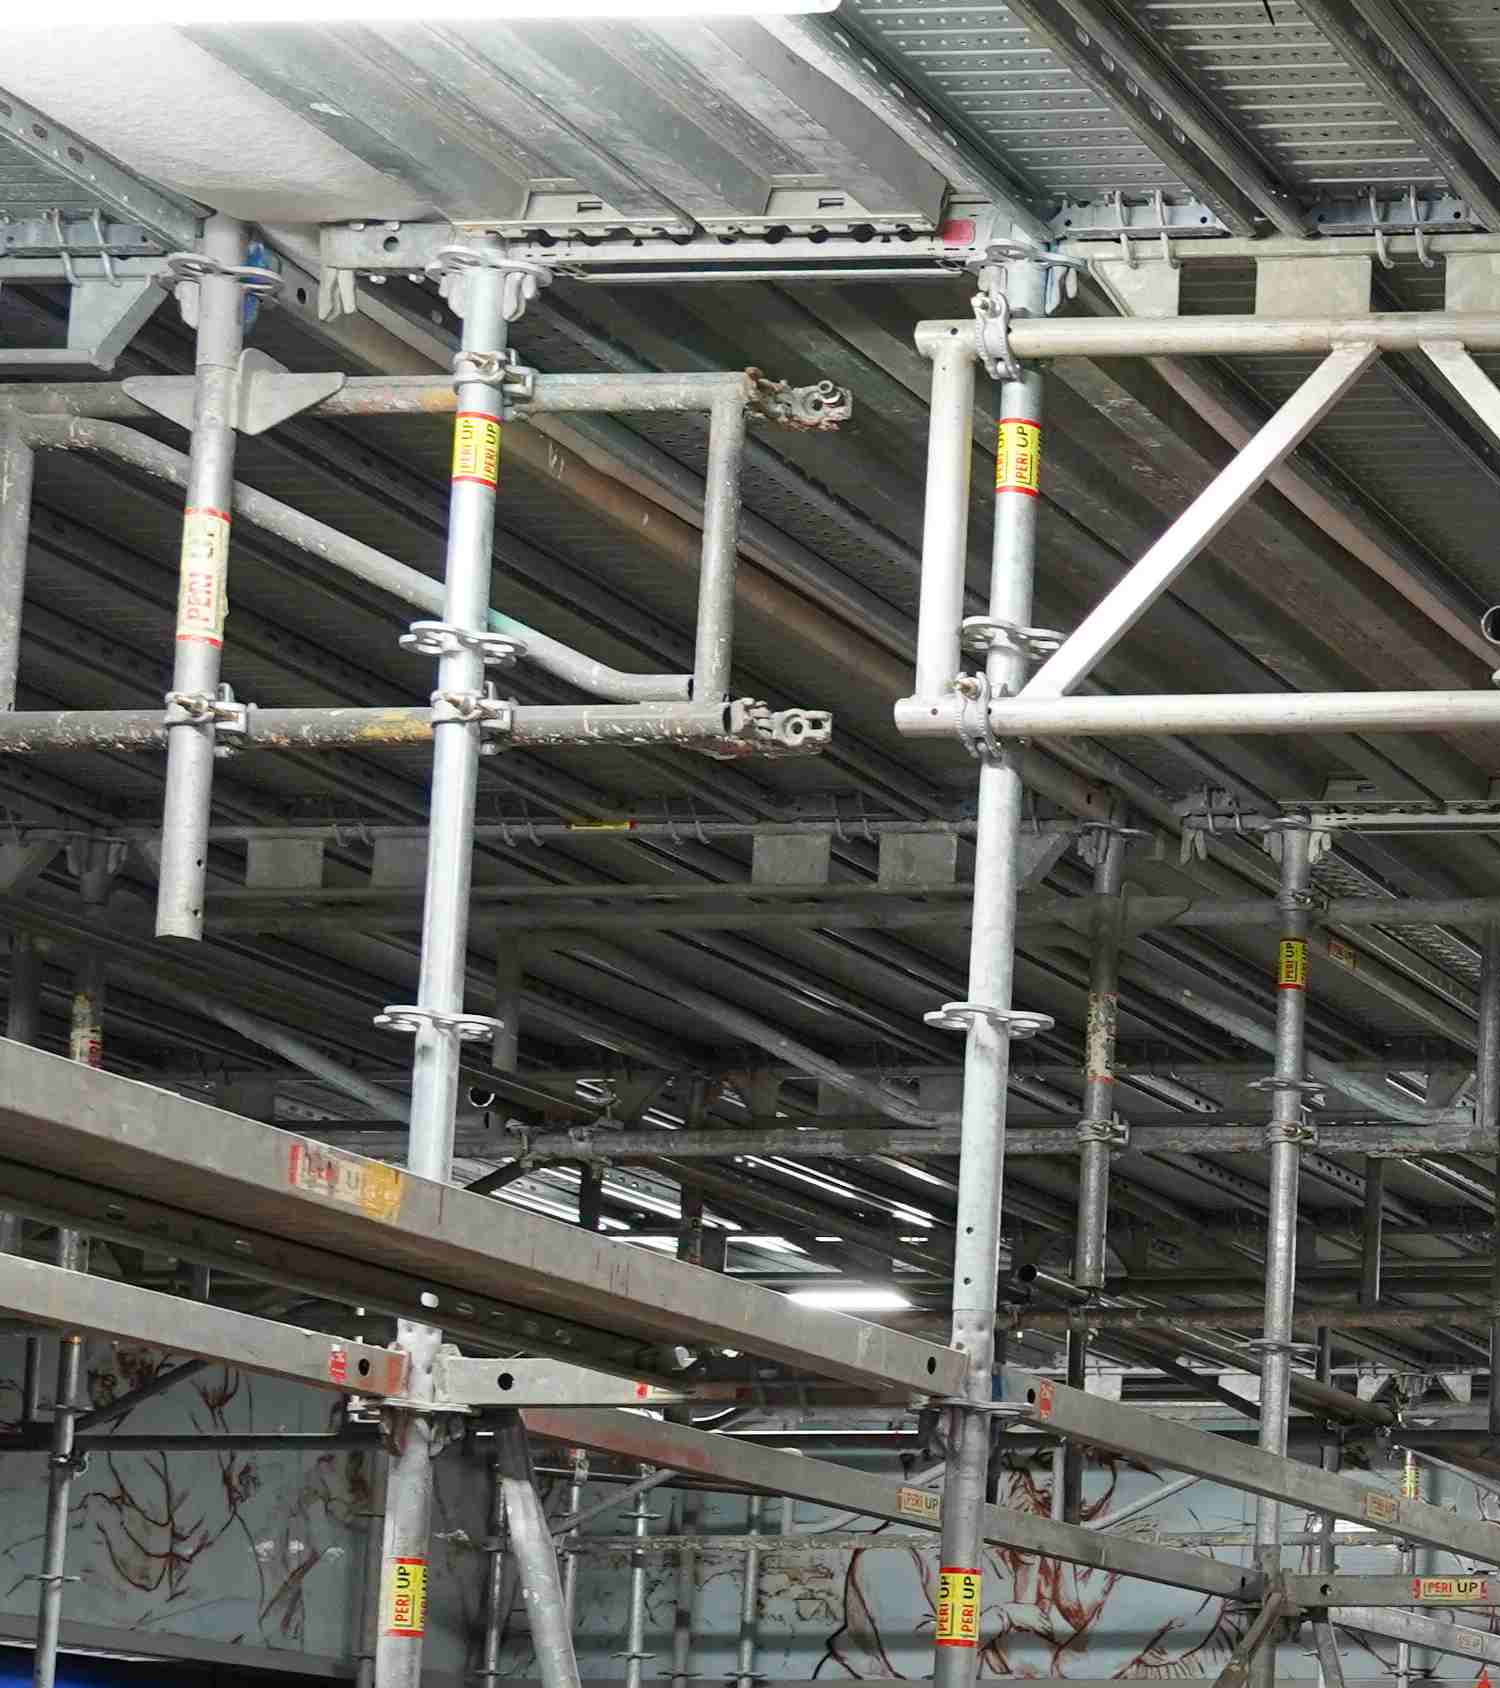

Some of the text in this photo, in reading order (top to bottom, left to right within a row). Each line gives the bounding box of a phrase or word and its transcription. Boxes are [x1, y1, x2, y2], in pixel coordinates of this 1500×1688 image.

[460, 419, 474, 474] PERI UP
[483, 424, 497, 476] PERI UP
[1015, 426, 1029, 480] PERI UP
[1284, 943, 1295, 980] PERI UP
[925, 1496, 938, 1510] UP
[395, 1566, 410, 1623] PERI UP
[938, 1576, 950, 1632] PERI UP
[961, 1576, 975, 1632] PERI UP
[1426, 1582, 1478, 1594] PERI UP
